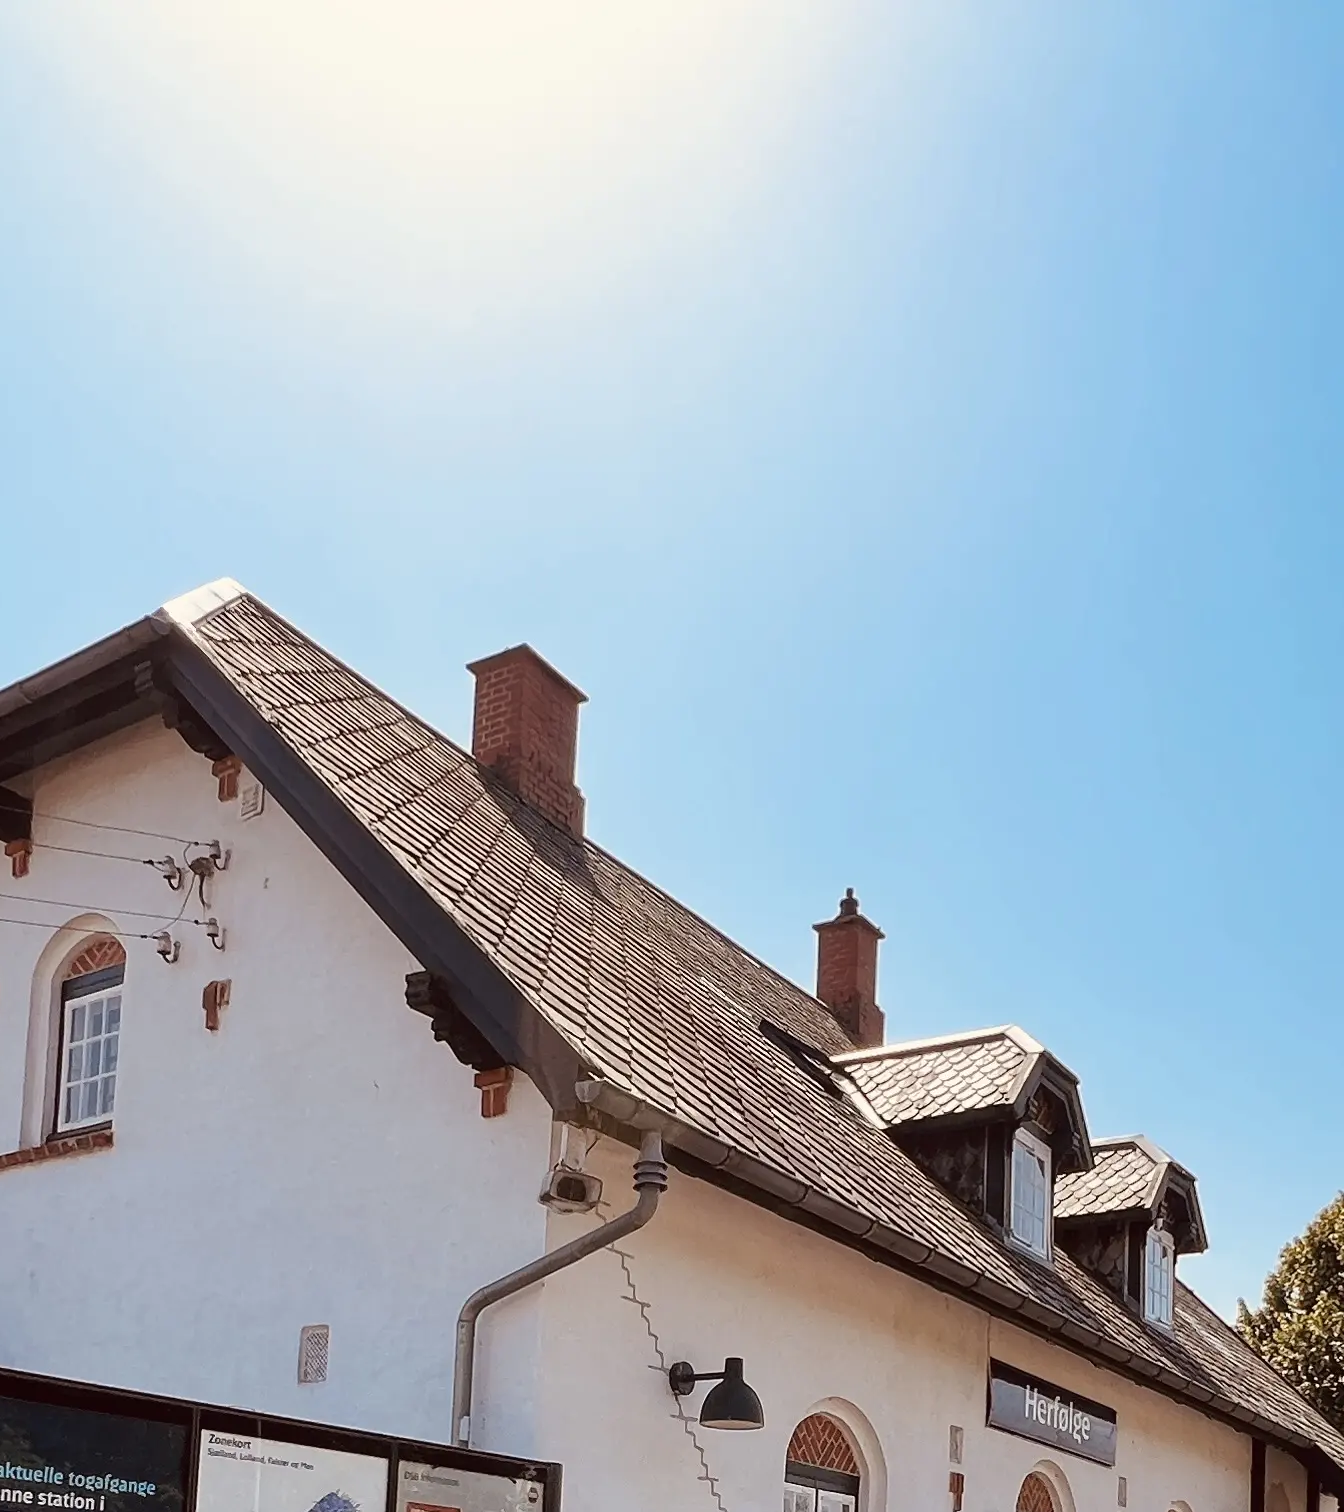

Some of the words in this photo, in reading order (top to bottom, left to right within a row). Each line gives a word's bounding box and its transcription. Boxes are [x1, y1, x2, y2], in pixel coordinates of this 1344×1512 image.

[1024, 1384, 1091, 1445] Herfølge
[209, 1433, 252, 1449] Zonekort
[68, 1471, 156, 1498] togafgange
[37, 1491, 95, 1511] station
[99, 1495, 105, 1512] i
